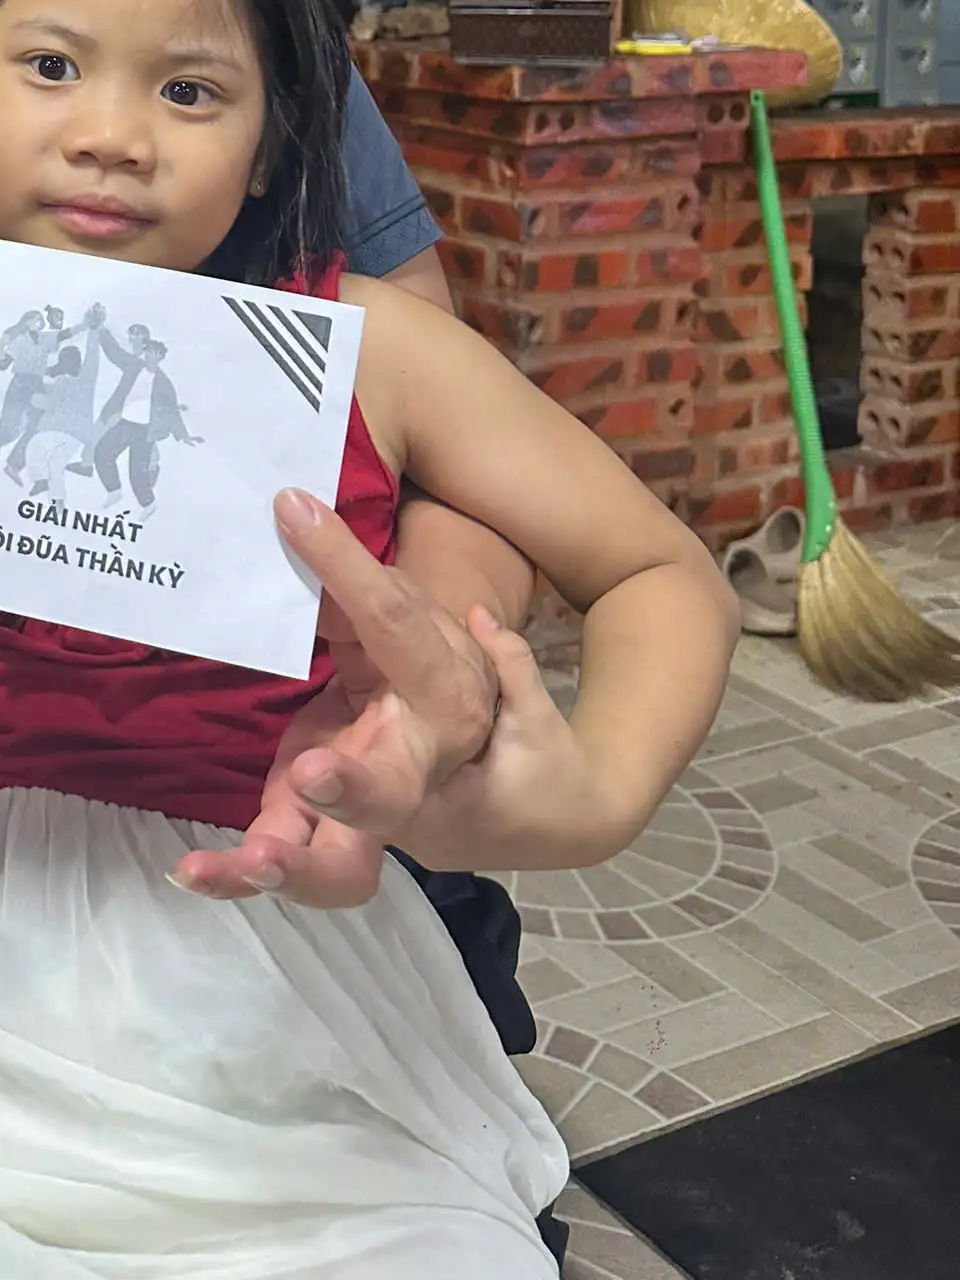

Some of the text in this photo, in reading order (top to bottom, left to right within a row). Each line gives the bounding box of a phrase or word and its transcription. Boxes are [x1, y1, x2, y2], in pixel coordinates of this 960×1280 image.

[17, 499, 143, 543] GIẢI NHẤT
[17, 535, 70, 564] ĐŨA
[75, 544, 145, 581] THẦN
[148, 562, 185, 589] KỲ
